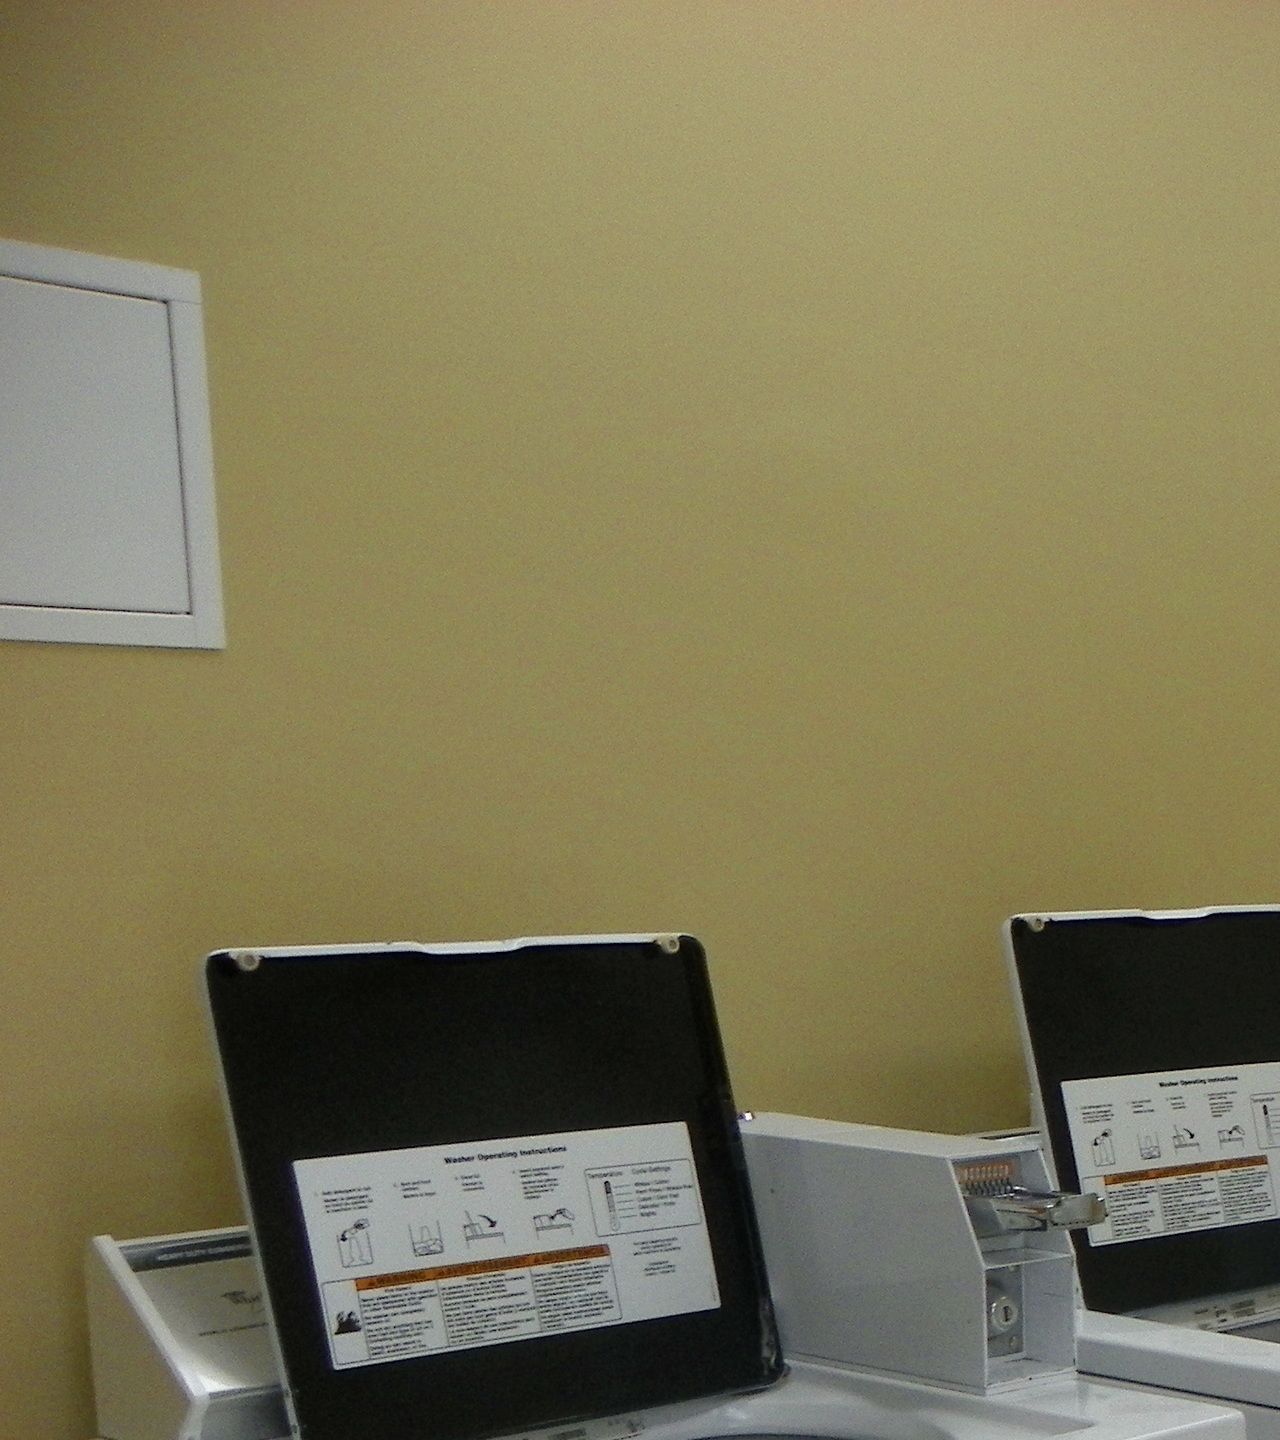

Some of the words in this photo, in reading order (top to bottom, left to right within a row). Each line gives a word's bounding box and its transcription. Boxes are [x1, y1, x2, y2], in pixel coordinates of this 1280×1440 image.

[444, 1156, 475, 1164] Washer
[478, 1151, 518, 1161] Operating
[519, 1146, 567, 1156] Instructions
